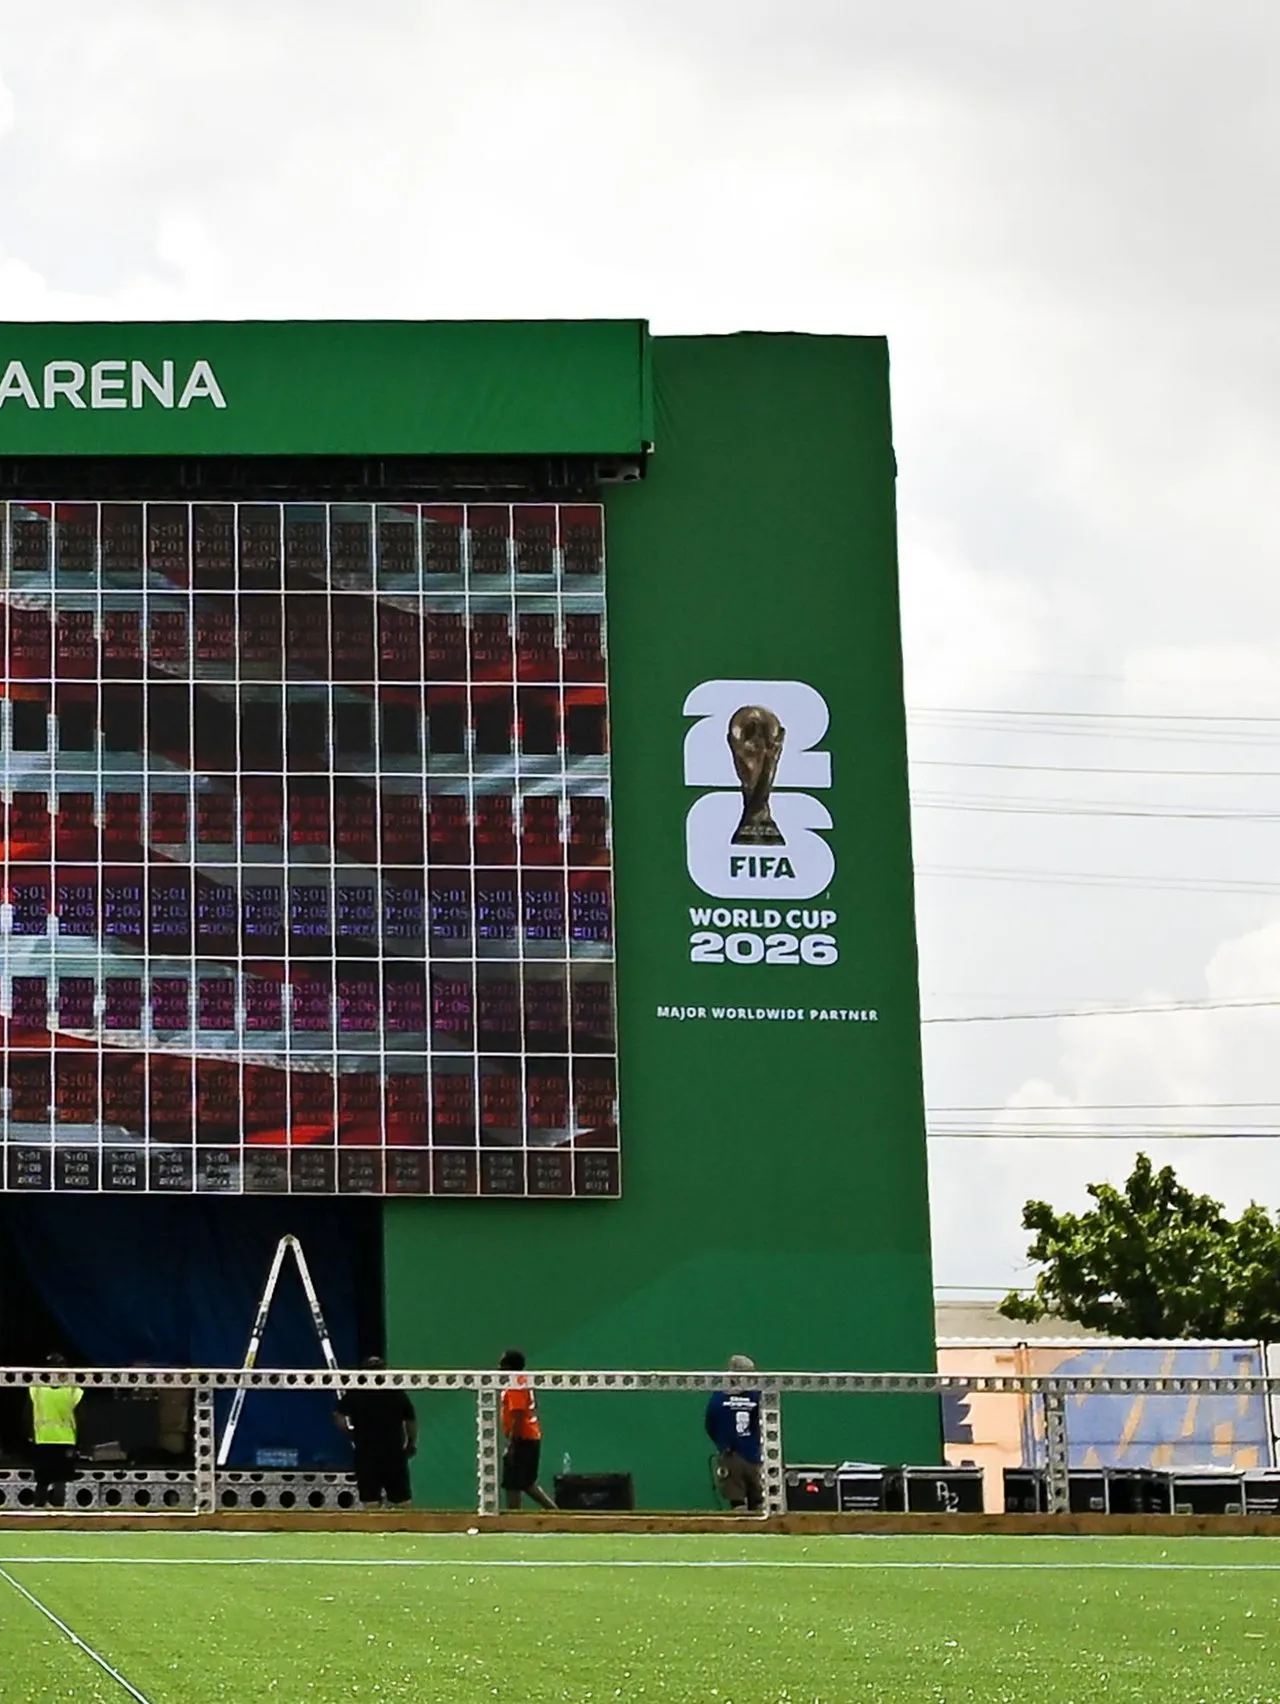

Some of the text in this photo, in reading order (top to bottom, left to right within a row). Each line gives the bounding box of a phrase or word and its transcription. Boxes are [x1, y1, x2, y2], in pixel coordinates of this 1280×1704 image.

[730, 856, 795, 879] FIFA
[689, 907, 837, 930] WORLD CUP
[690, 931, 838, 965] 2026
[657, 1005, 878, 1021] MAJOR WORLDWIDE PARTNER
